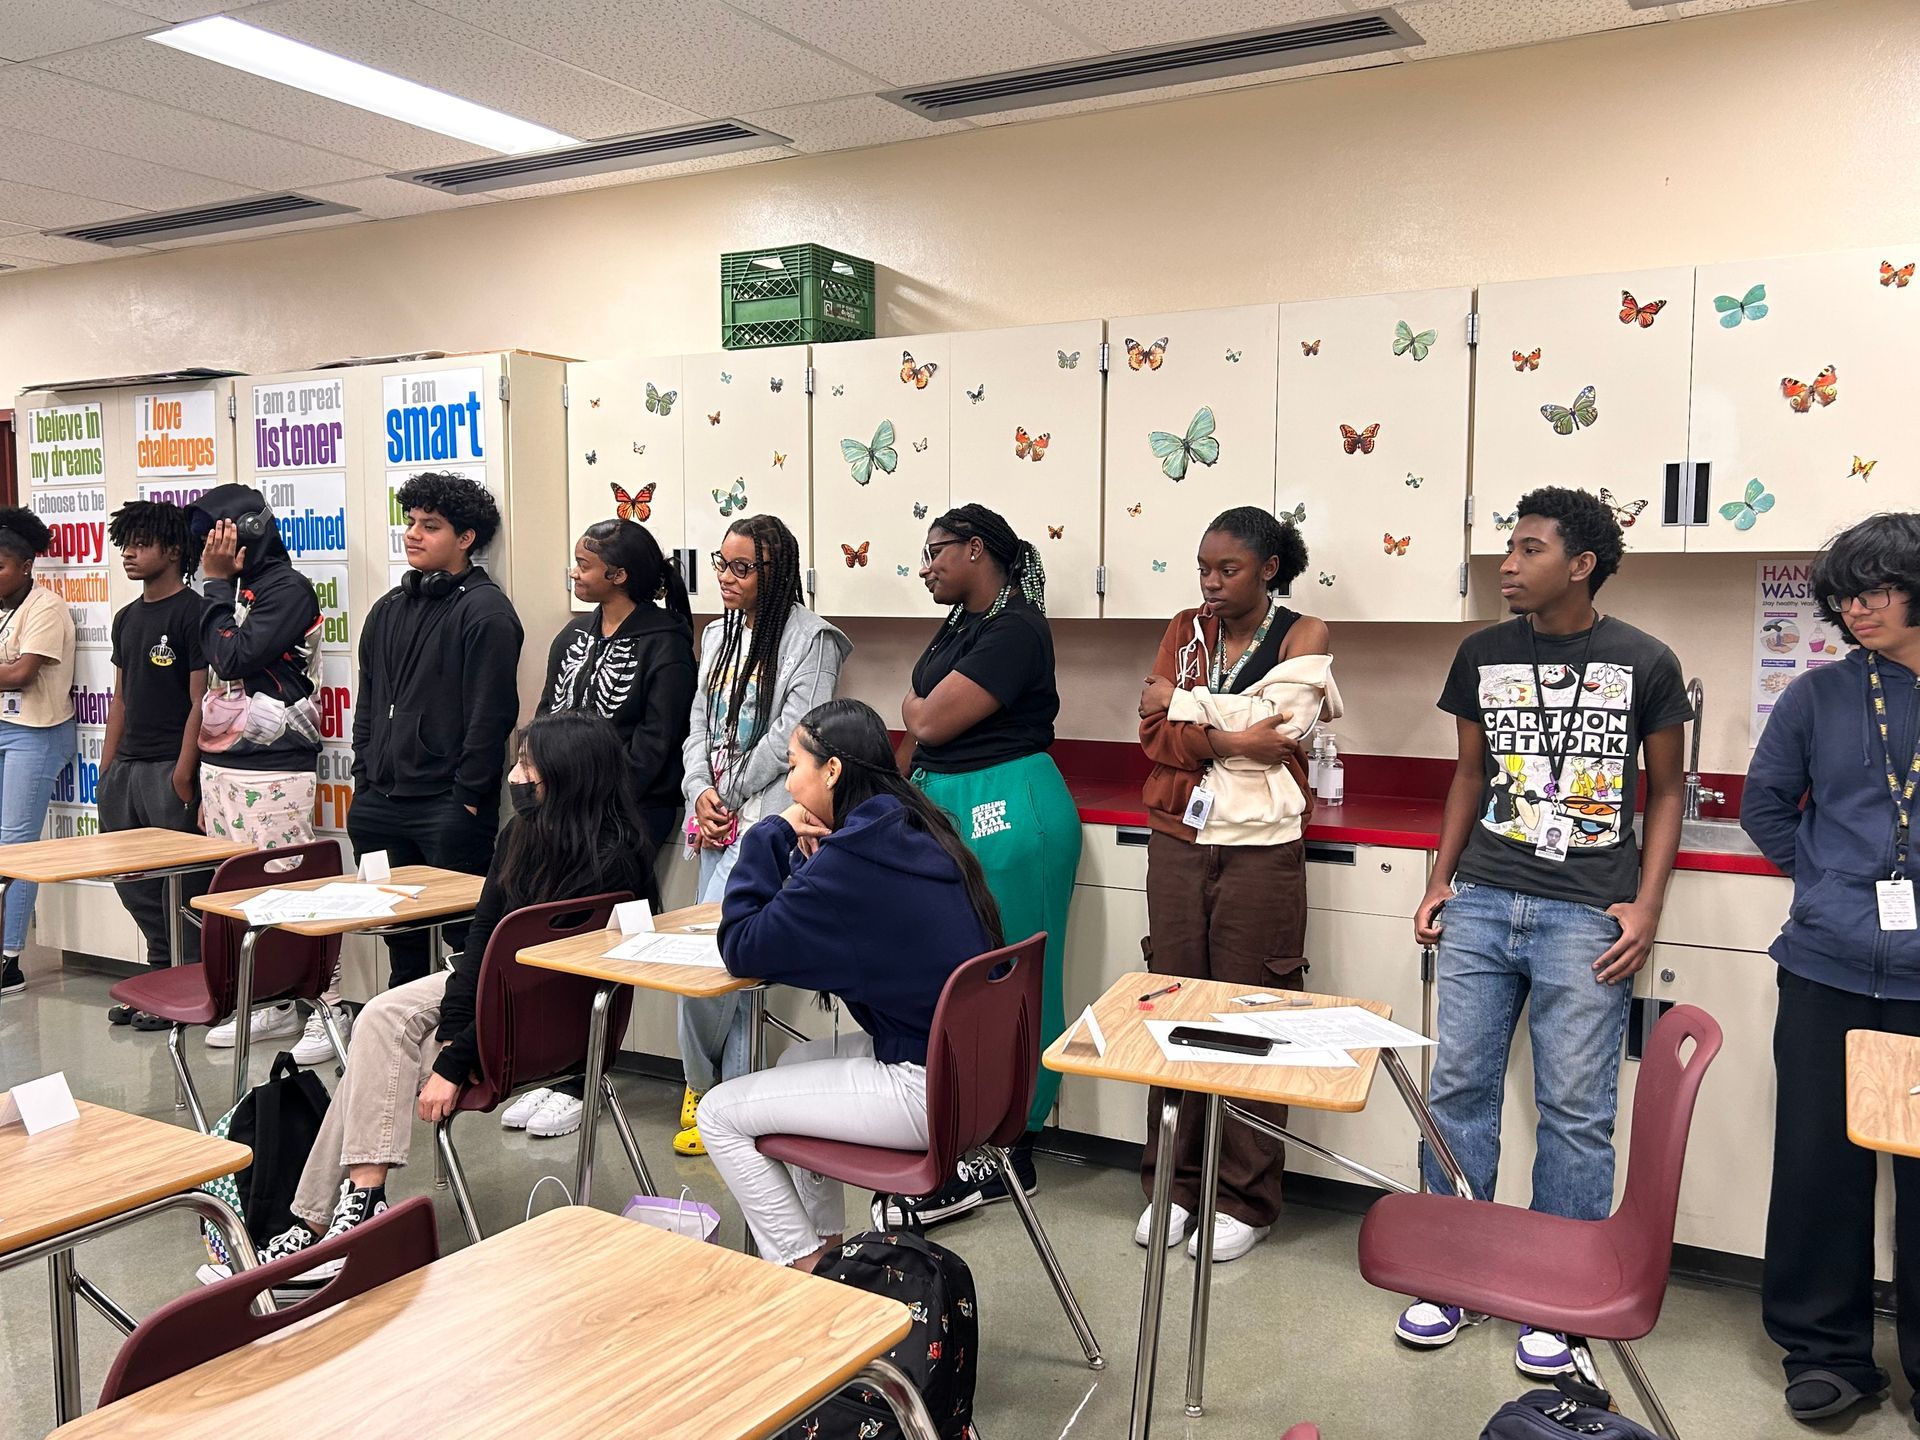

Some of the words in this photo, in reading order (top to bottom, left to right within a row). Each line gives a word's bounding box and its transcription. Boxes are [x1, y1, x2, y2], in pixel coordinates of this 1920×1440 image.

[255, 389, 260, 415] i
[263, 390, 284, 415] am
[287, 390, 296, 413] a
[299, 382, 341, 416] great
[402, 378, 407, 404] i
[412, 379, 436, 403] am
[28, 411, 34, 444] i
[36, 410, 84, 444] believe
[84, 406, 101, 439] in
[144, 397, 149, 431] i
[152, 396, 182, 431] love
[386, 391, 483, 463] smart
[137, 433, 215, 471] challenges
[255, 418, 342, 468] listener
[31, 449, 50, 483] my
[51, 445, 103, 478] dreams
[32, 493, 37, 514] i
[38, 493, 76, 514] choose
[77, 491, 90, 512] to
[90, 490, 104, 511] be
[271, 482, 295, 507] am
[36, 521, 105, 564] appy
[54, 573, 63, 599] is
[64, 571, 109, 603] beautiful
[1763, 565, 1812, 581] HAN
[76, 625, 109, 642] oment
[1483, 711, 1628, 733] CARTOON
[82, 733, 87, 759] i
[1485, 731, 1627, 756] NETWORK
[333, 750, 353, 780] to
[55, 813, 73, 839] am
[972, 806, 1006, 823] FEELS
